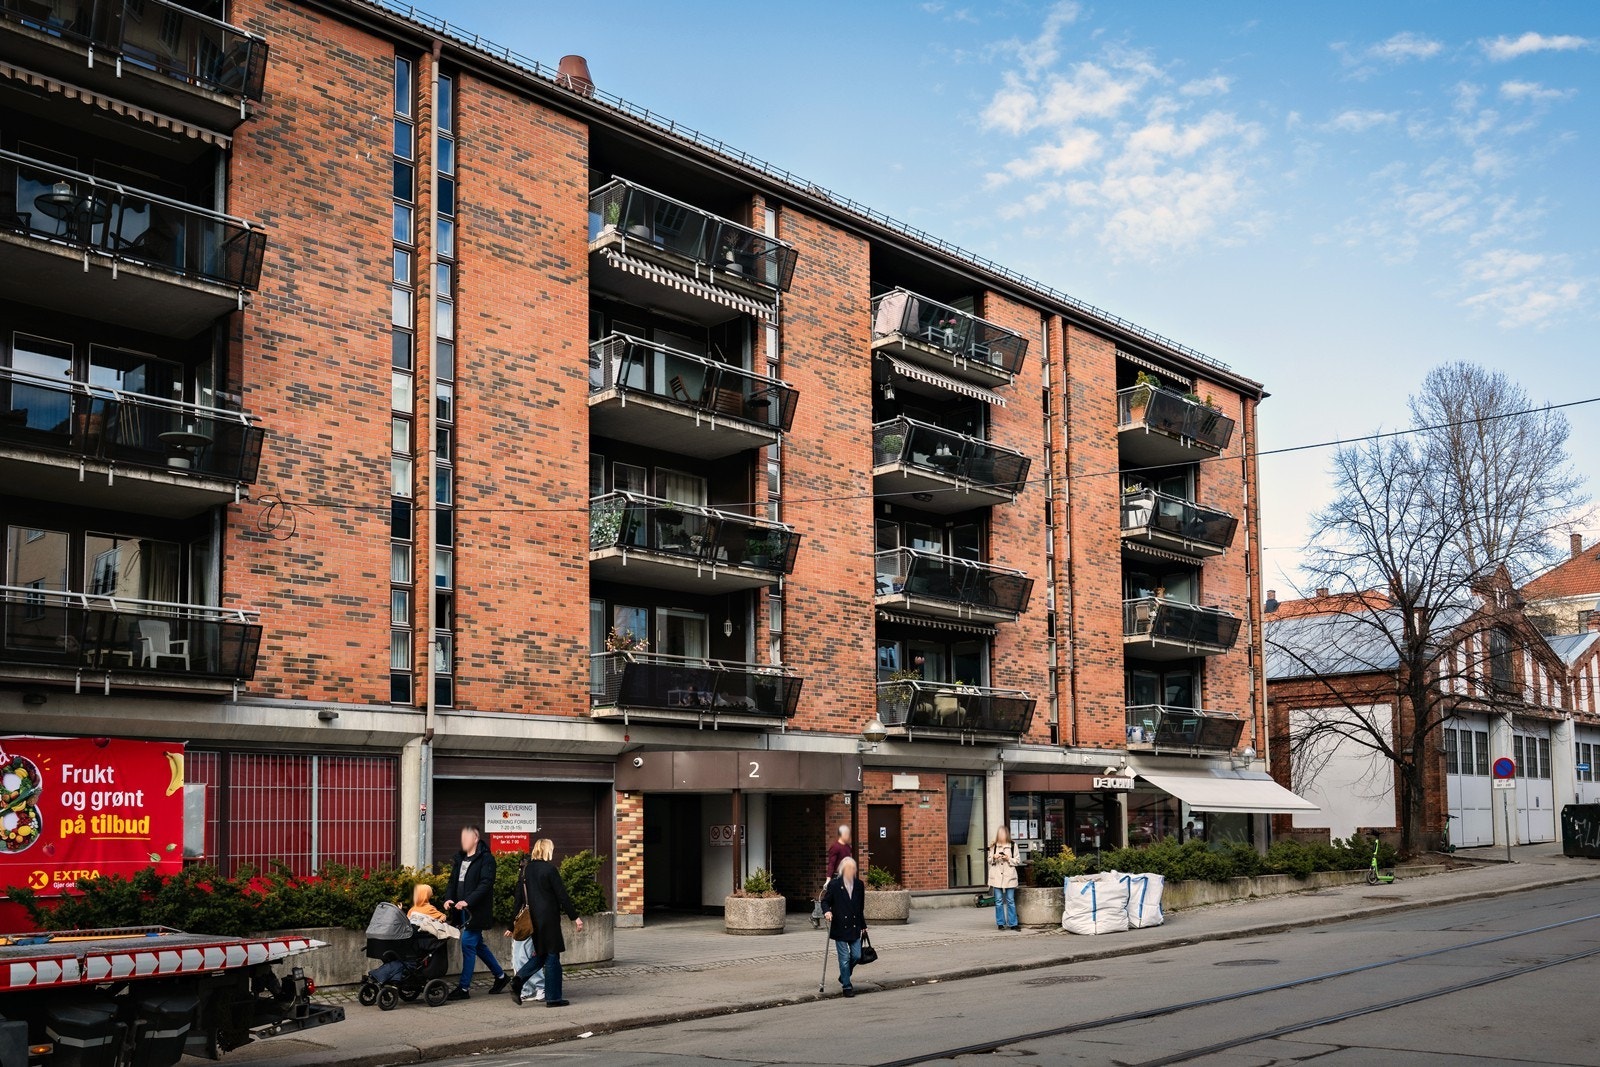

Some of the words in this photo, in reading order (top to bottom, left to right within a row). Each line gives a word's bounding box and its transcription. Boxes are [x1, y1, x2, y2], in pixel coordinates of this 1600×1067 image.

[62, 764, 114, 783] Frukt
[749, 761, 759, 777] 2
[61, 791, 86, 811] og
[91, 790, 144, 811] grønt
[60, 814, 86, 838] på
[91, 814, 150, 834] tilbud
[53, 869, 100, 881] EXTRA
